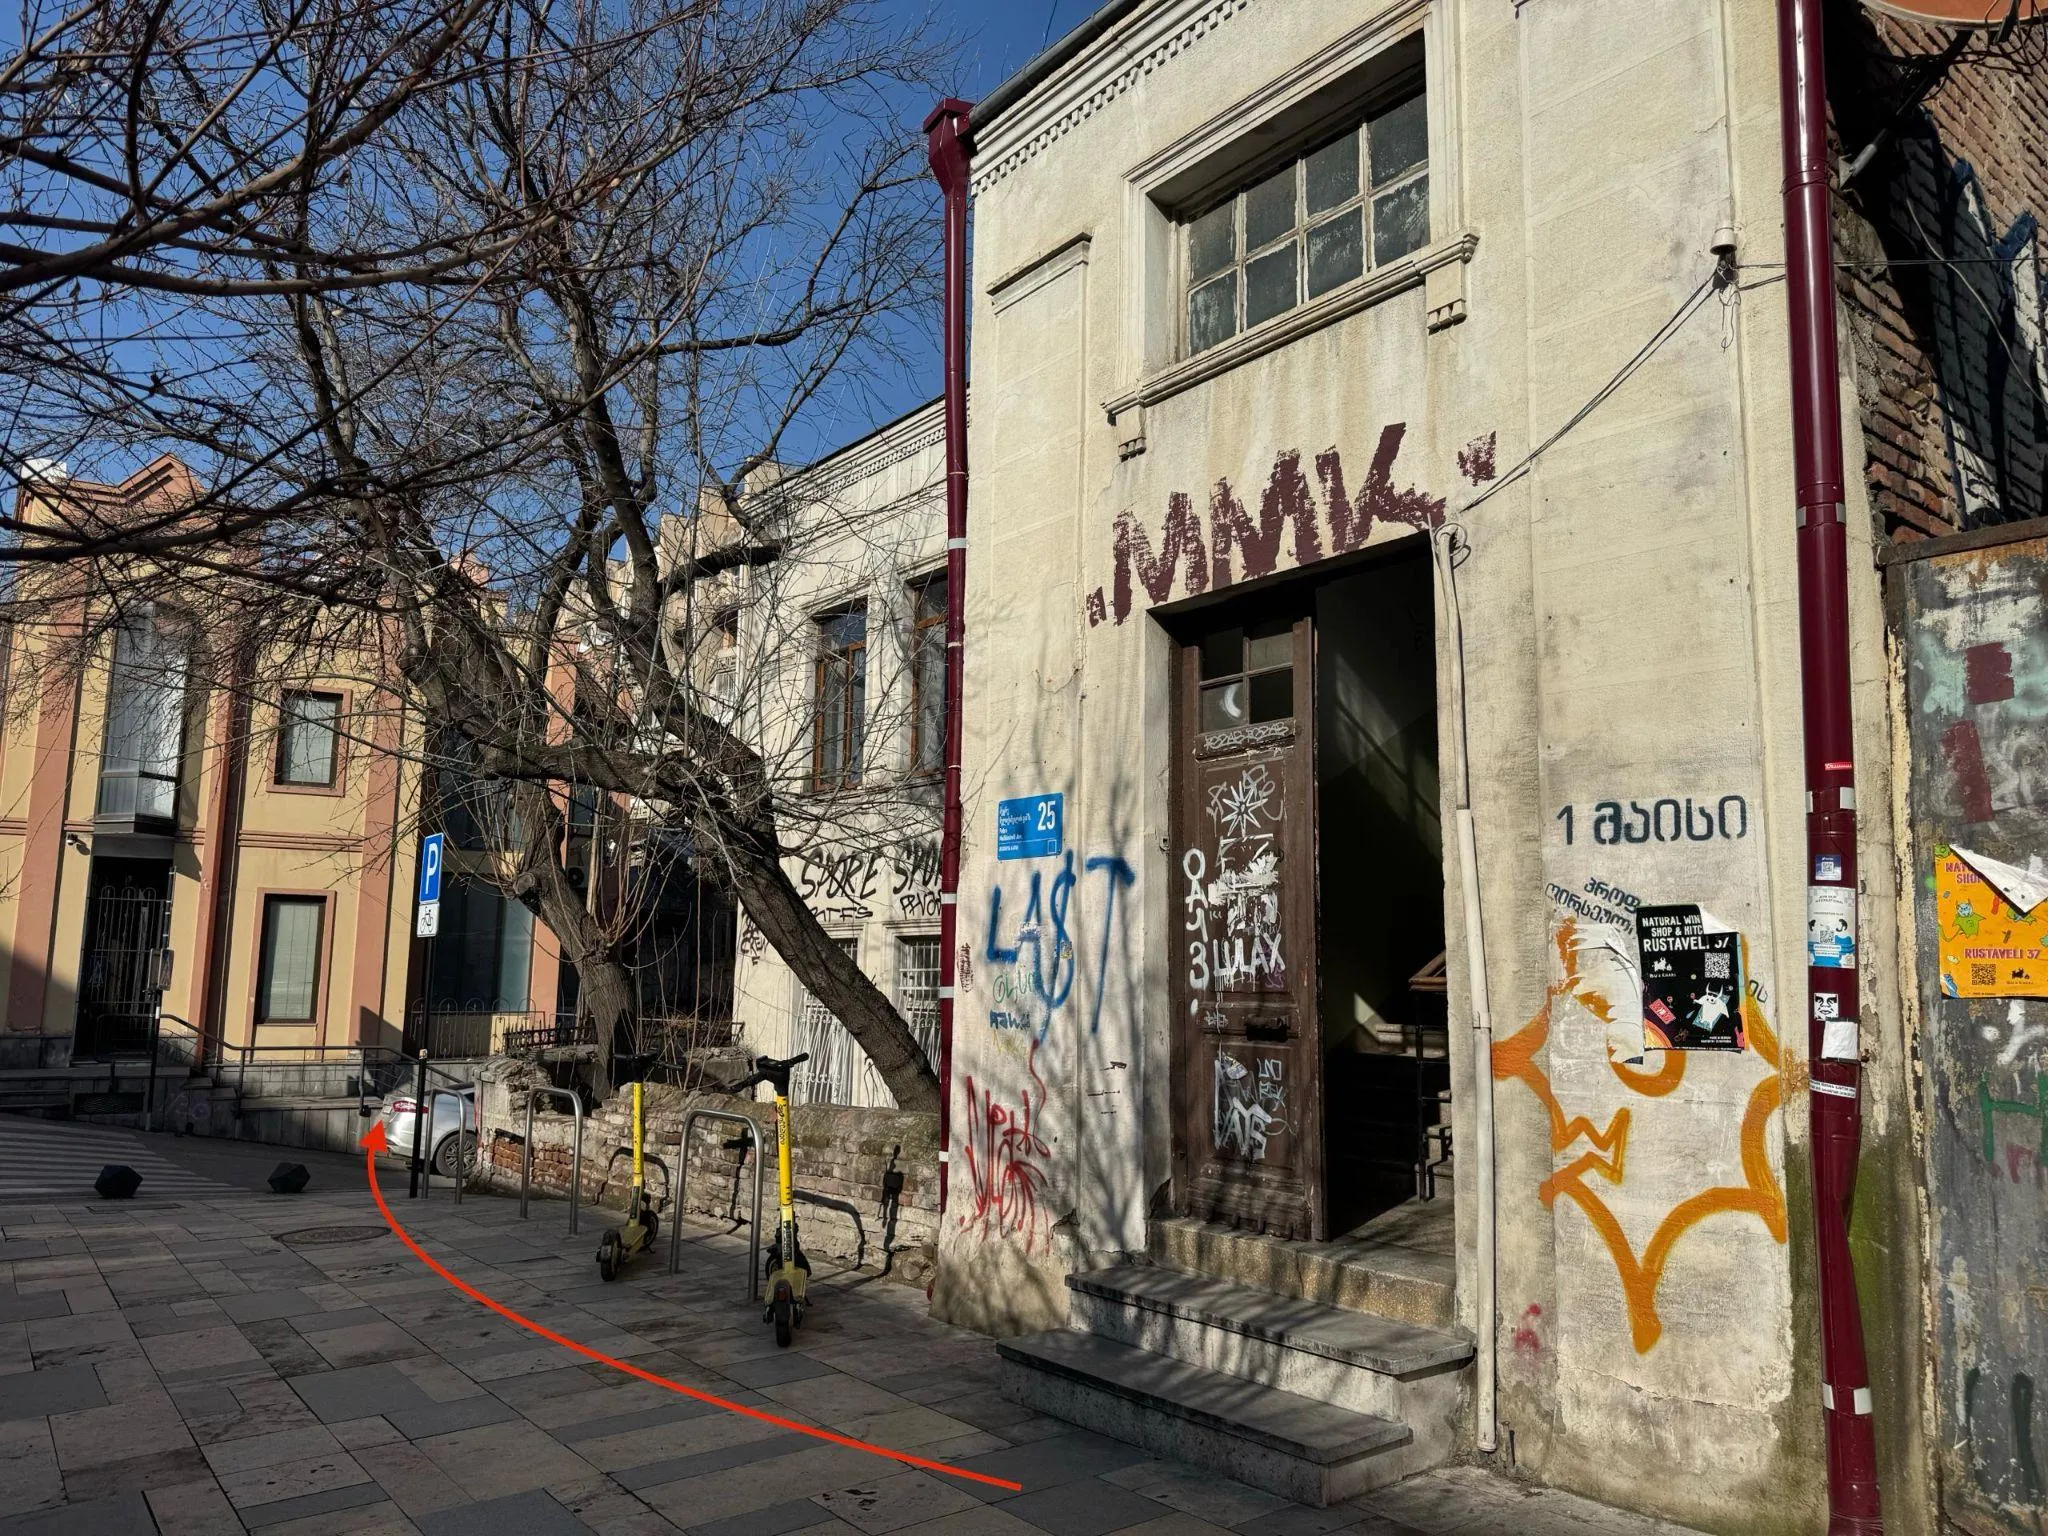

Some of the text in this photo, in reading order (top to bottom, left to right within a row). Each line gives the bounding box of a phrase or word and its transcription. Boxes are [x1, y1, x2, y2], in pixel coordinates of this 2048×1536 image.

[1037, 800, 1056, 831] 25
[1556, 794, 1748, 846] 1 მაისი
[424, 842, 439, 895] P
[1642, 914, 1701, 927] NATURAL WIN
[1651, 926, 1672, 937] SHOP
[1674, 927, 1682, 936] &
[1964, 948, 2040, 960] RUSTAVELI 37
